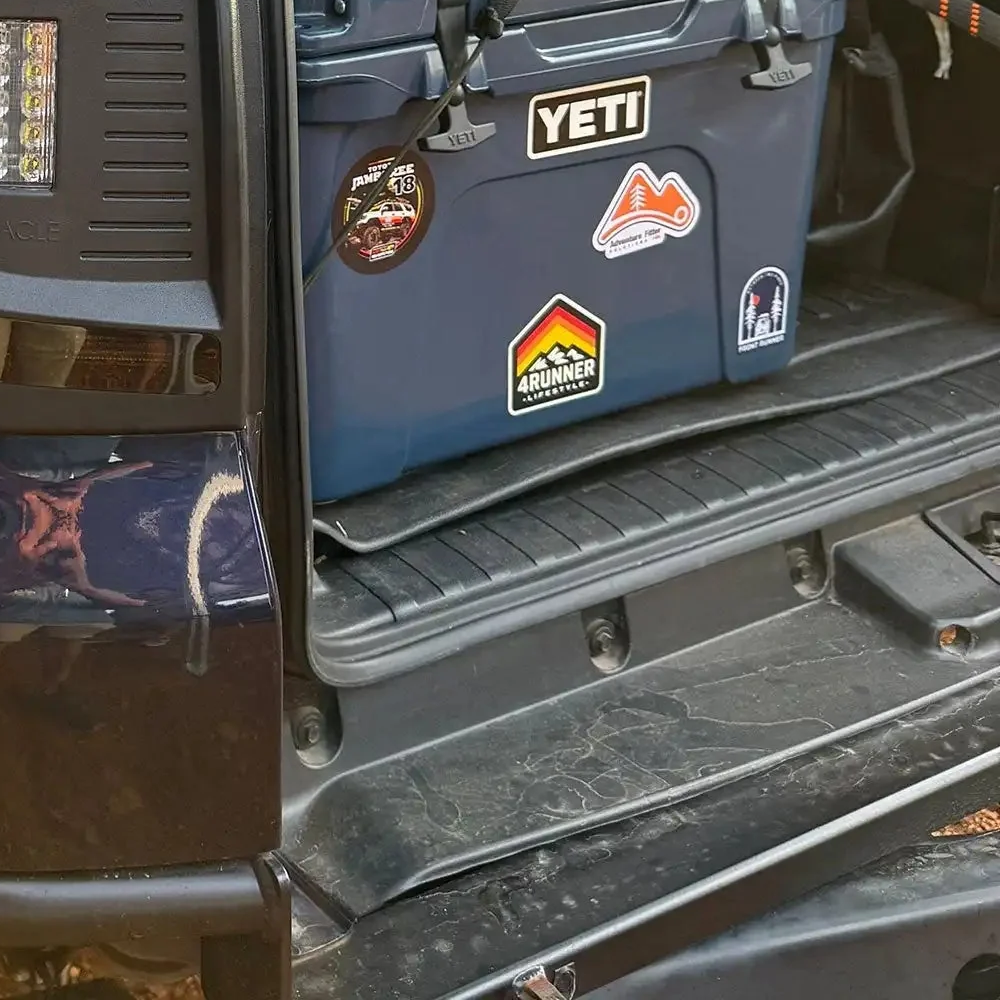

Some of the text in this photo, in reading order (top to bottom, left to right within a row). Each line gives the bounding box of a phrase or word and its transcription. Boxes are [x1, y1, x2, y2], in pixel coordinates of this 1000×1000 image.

[768, 69, 796, 84] YETI
[537, 90, 639, 144] YETI
[447, 128, 478, 147] YETI
[393, 175, 416, 196] 18
[517, 358, 596, 393] 4RUNNER
